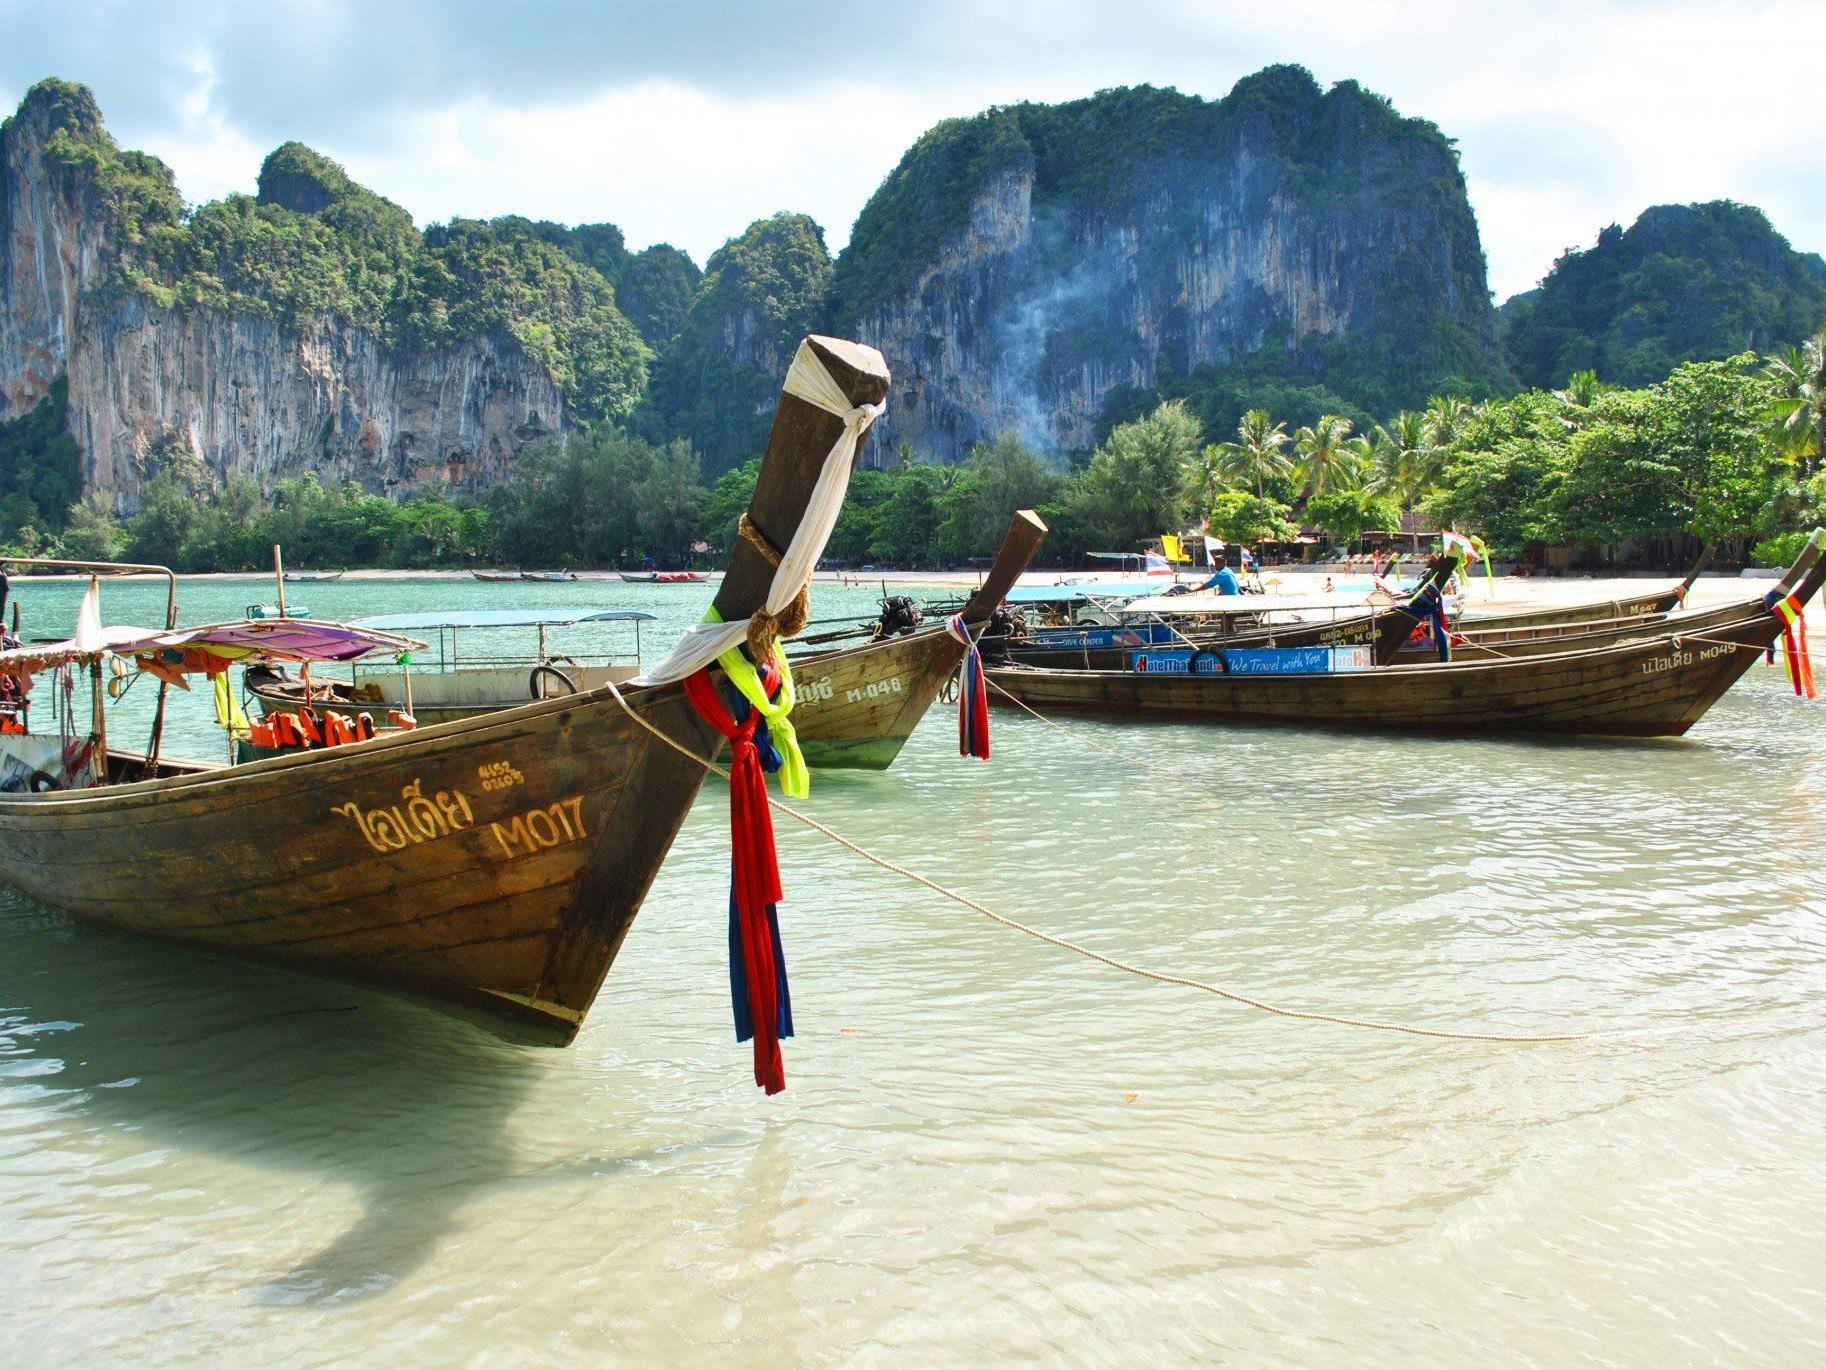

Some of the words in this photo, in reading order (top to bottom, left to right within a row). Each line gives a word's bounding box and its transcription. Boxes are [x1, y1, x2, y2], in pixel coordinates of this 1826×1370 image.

[1079, 637, 1104, 647] CNTER
[1250, 656, 1280, 671] Travel
[1282, 653, 1304, 670] with
